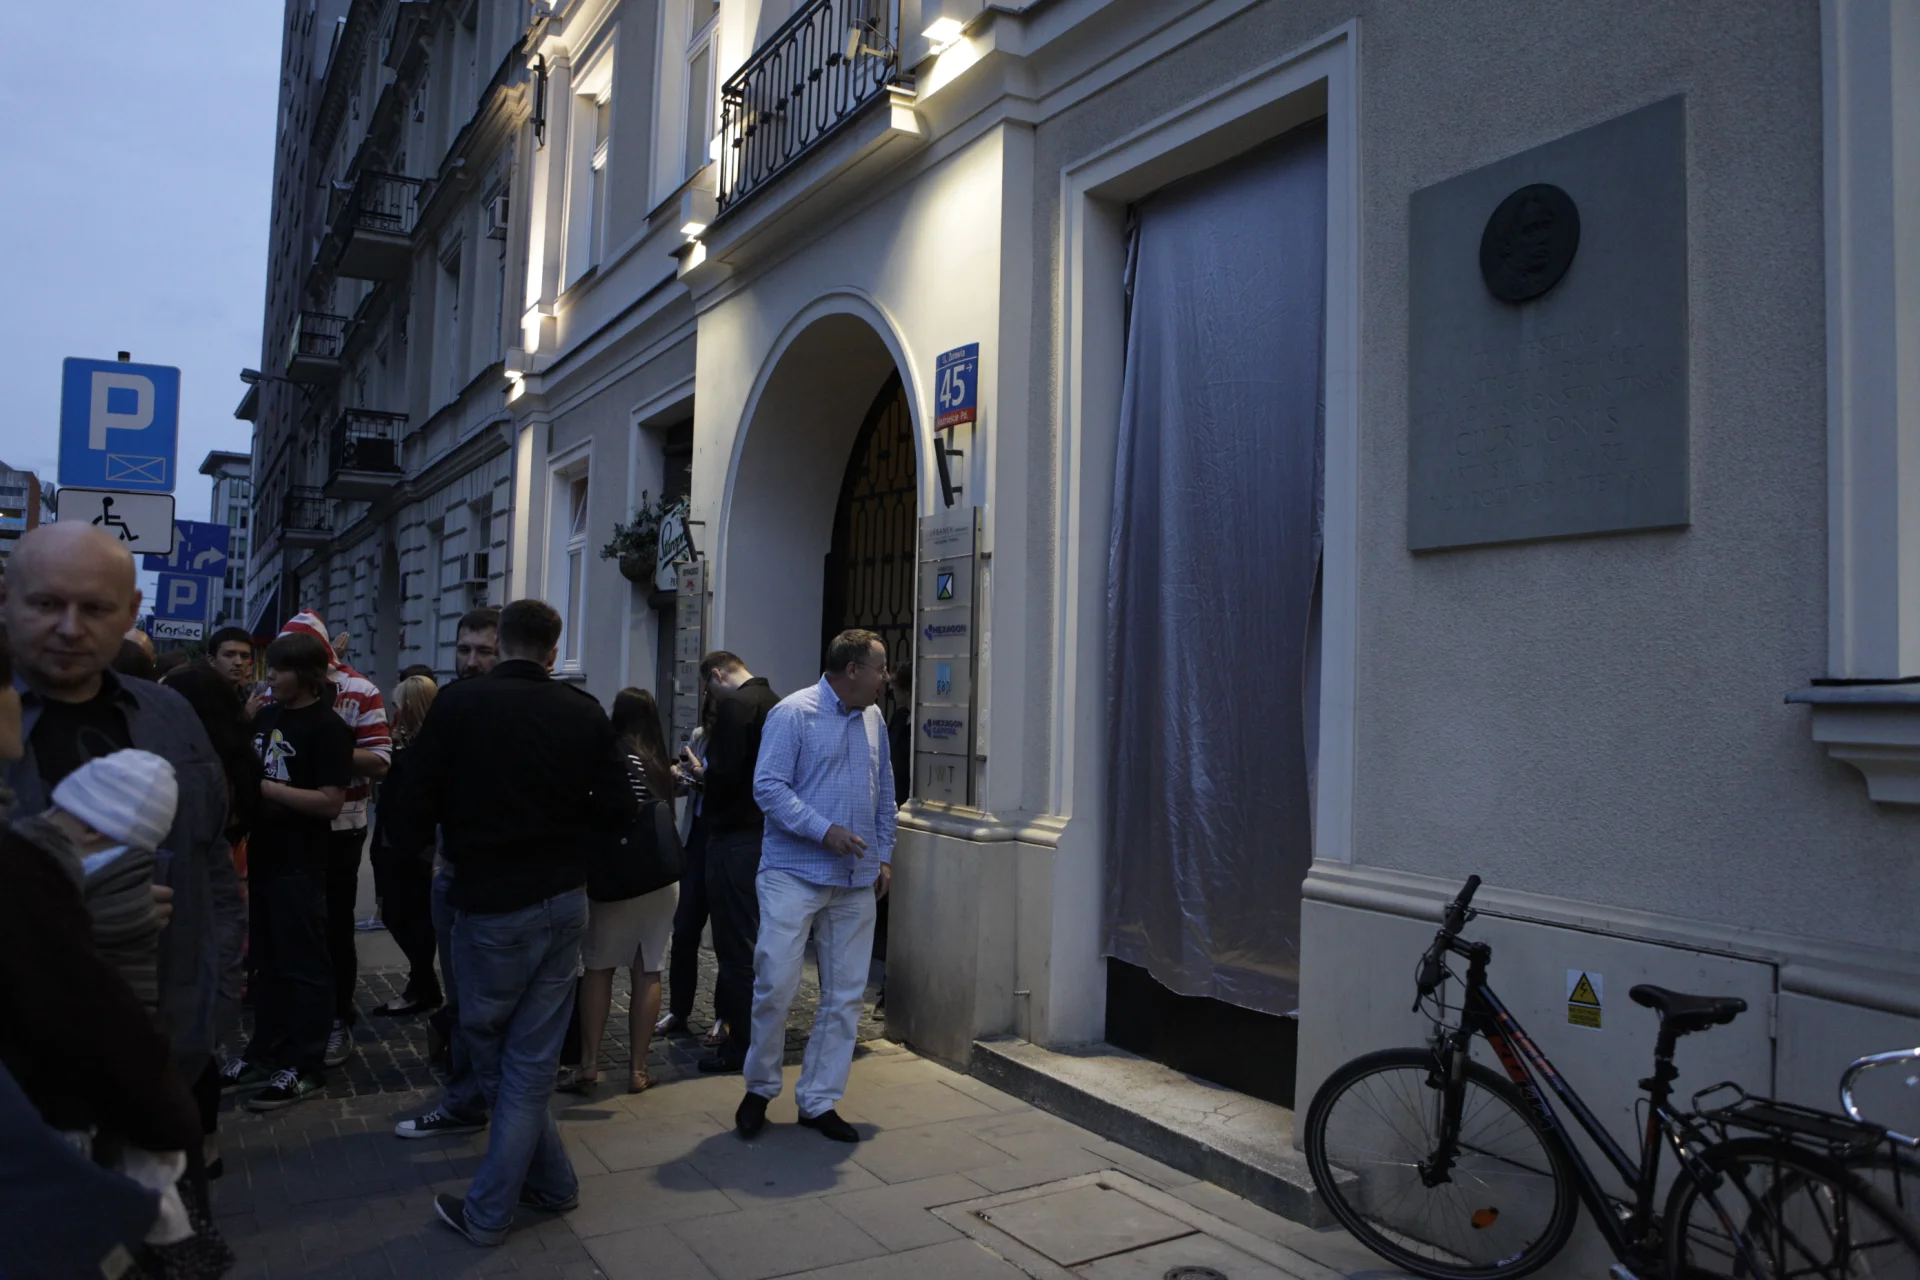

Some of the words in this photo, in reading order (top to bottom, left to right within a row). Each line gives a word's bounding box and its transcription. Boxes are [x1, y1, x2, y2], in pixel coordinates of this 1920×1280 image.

[940, 364, 965, 409] 45
[88, 371, 155, 450] P
[167, 579, 198, 614] P
[932, 624, 967, 634] HEXAGON
[933, 719, 963, 729] HEXAGON
